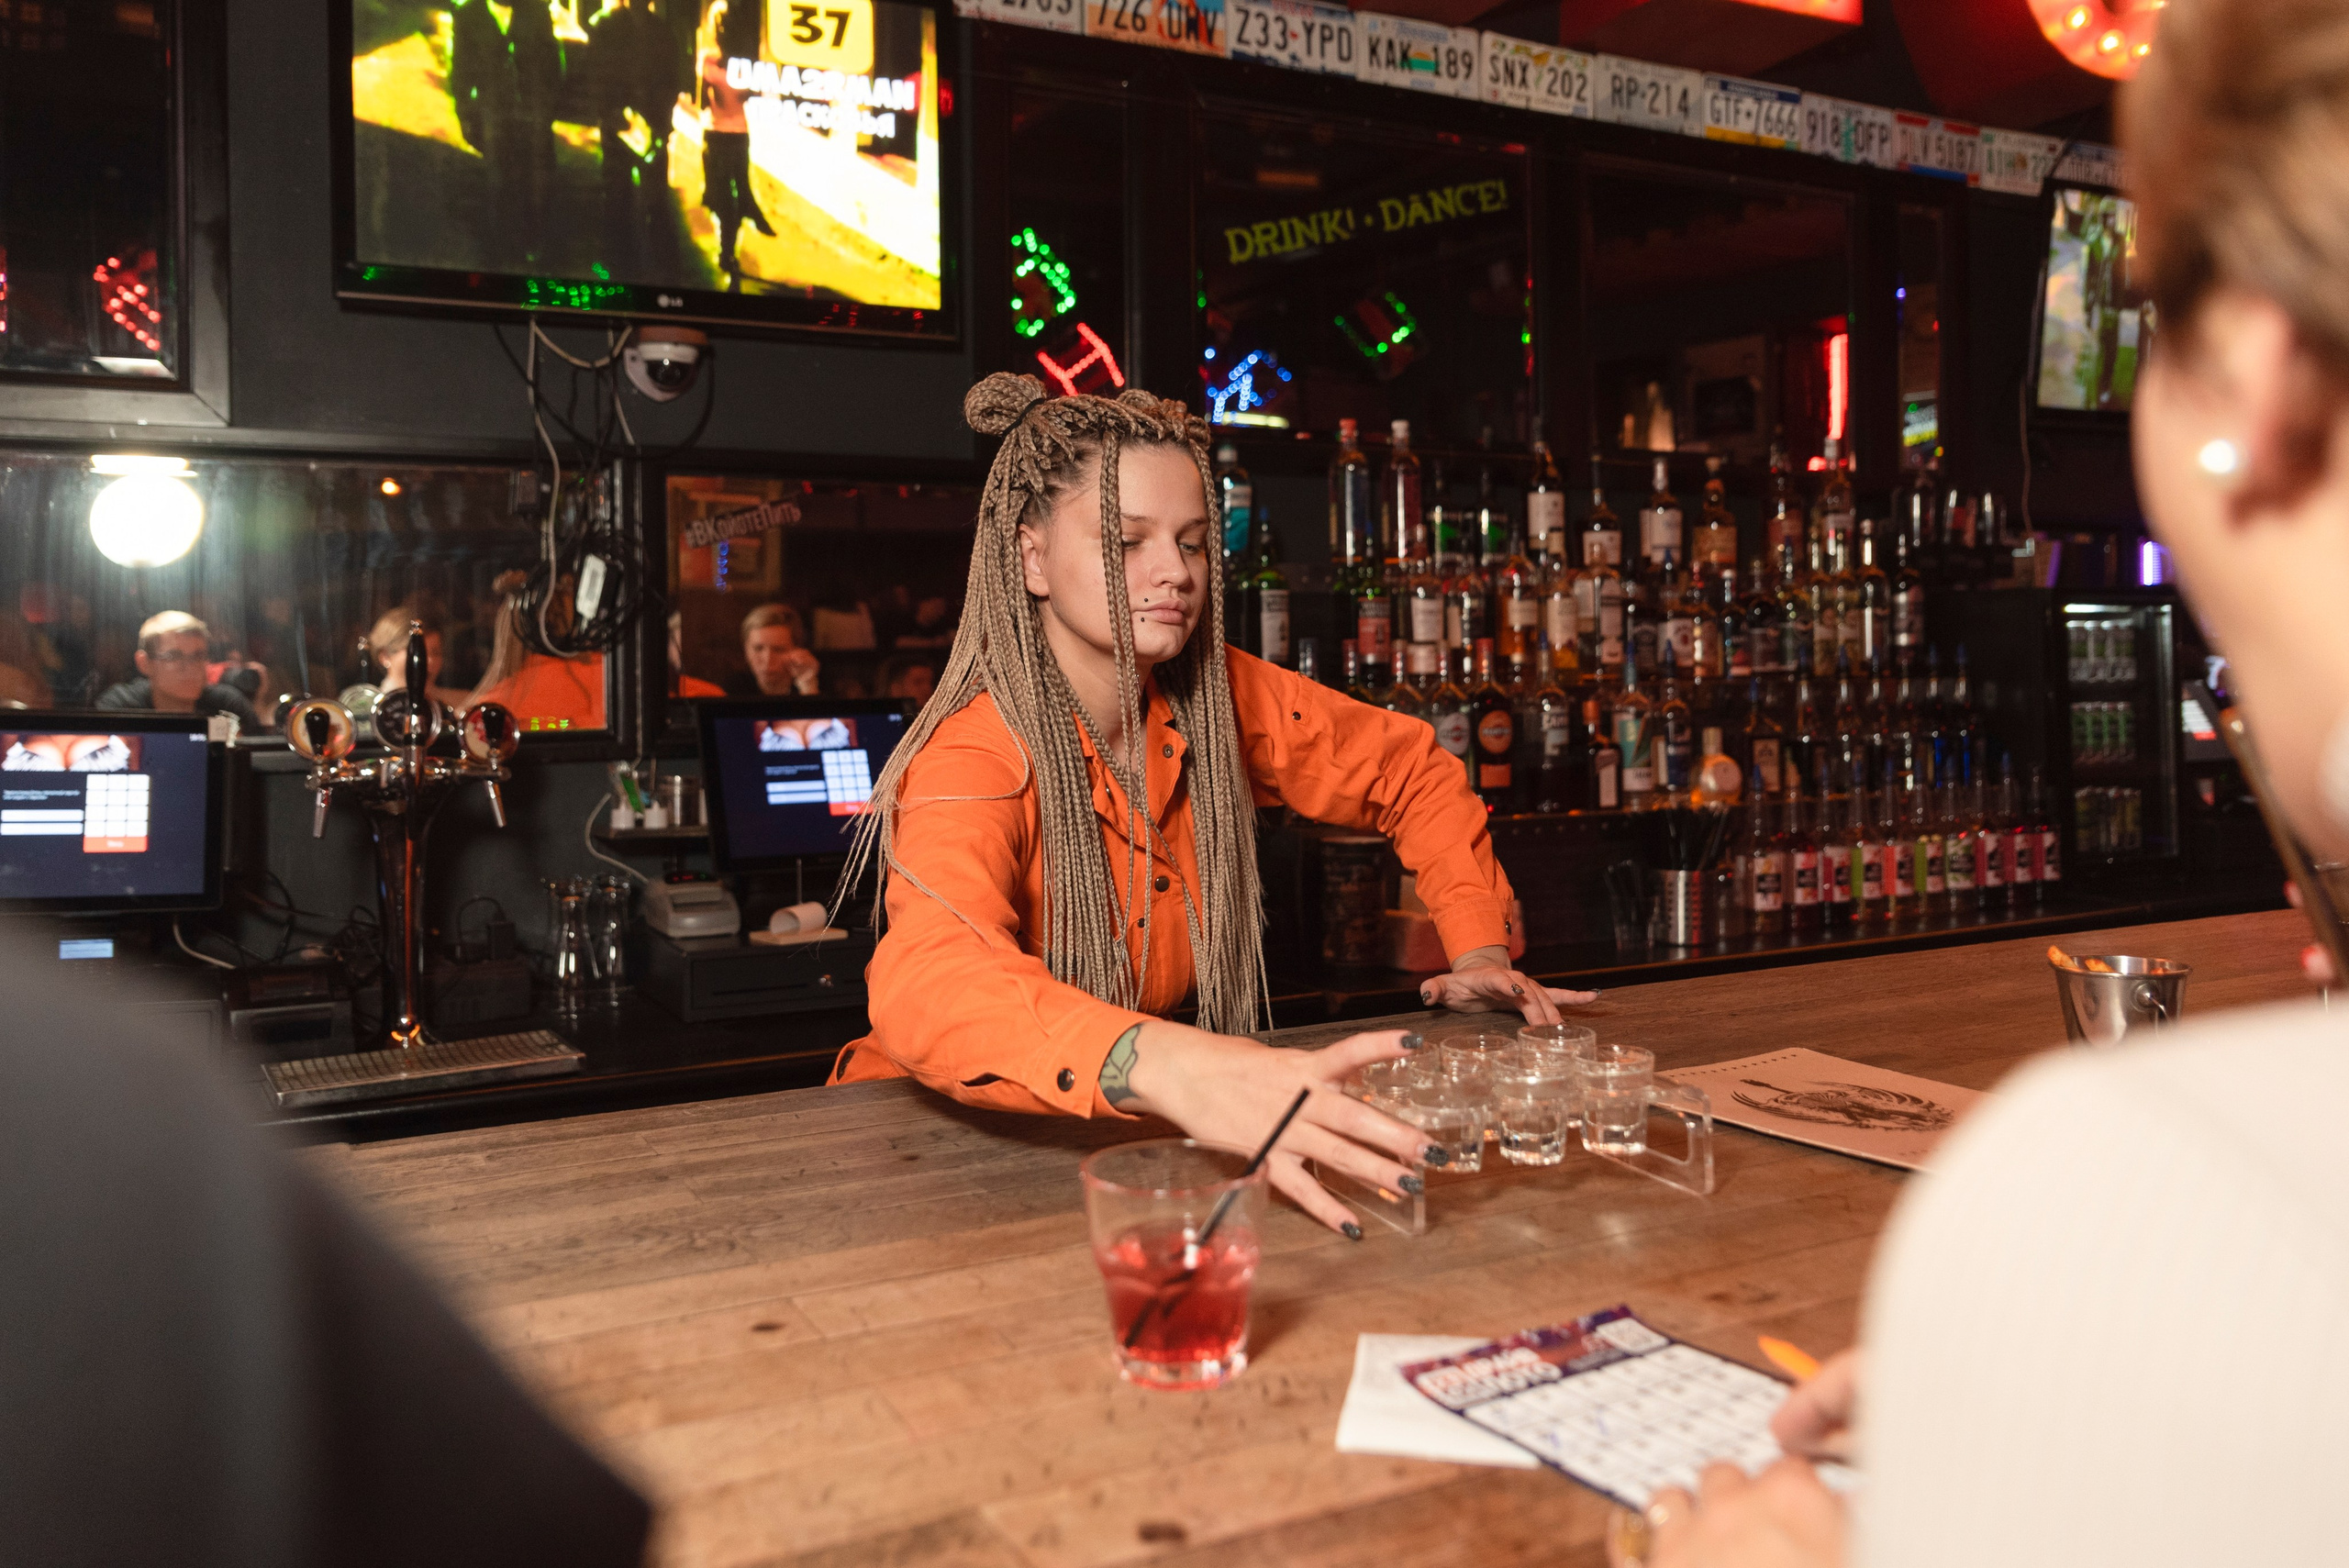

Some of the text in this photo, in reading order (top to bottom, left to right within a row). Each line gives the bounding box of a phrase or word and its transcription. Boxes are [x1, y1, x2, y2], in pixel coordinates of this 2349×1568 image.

[790, 4, 852, 49] 37
[1368, 36, 1413, 72] KAK
[1433, 45, 1473, 81] 189
[1489, 54, 1530, 88] SNX
[1547, 66, 1587, 103] 202
[1224, 179, 1509, 265] DRINK! DANCE!
